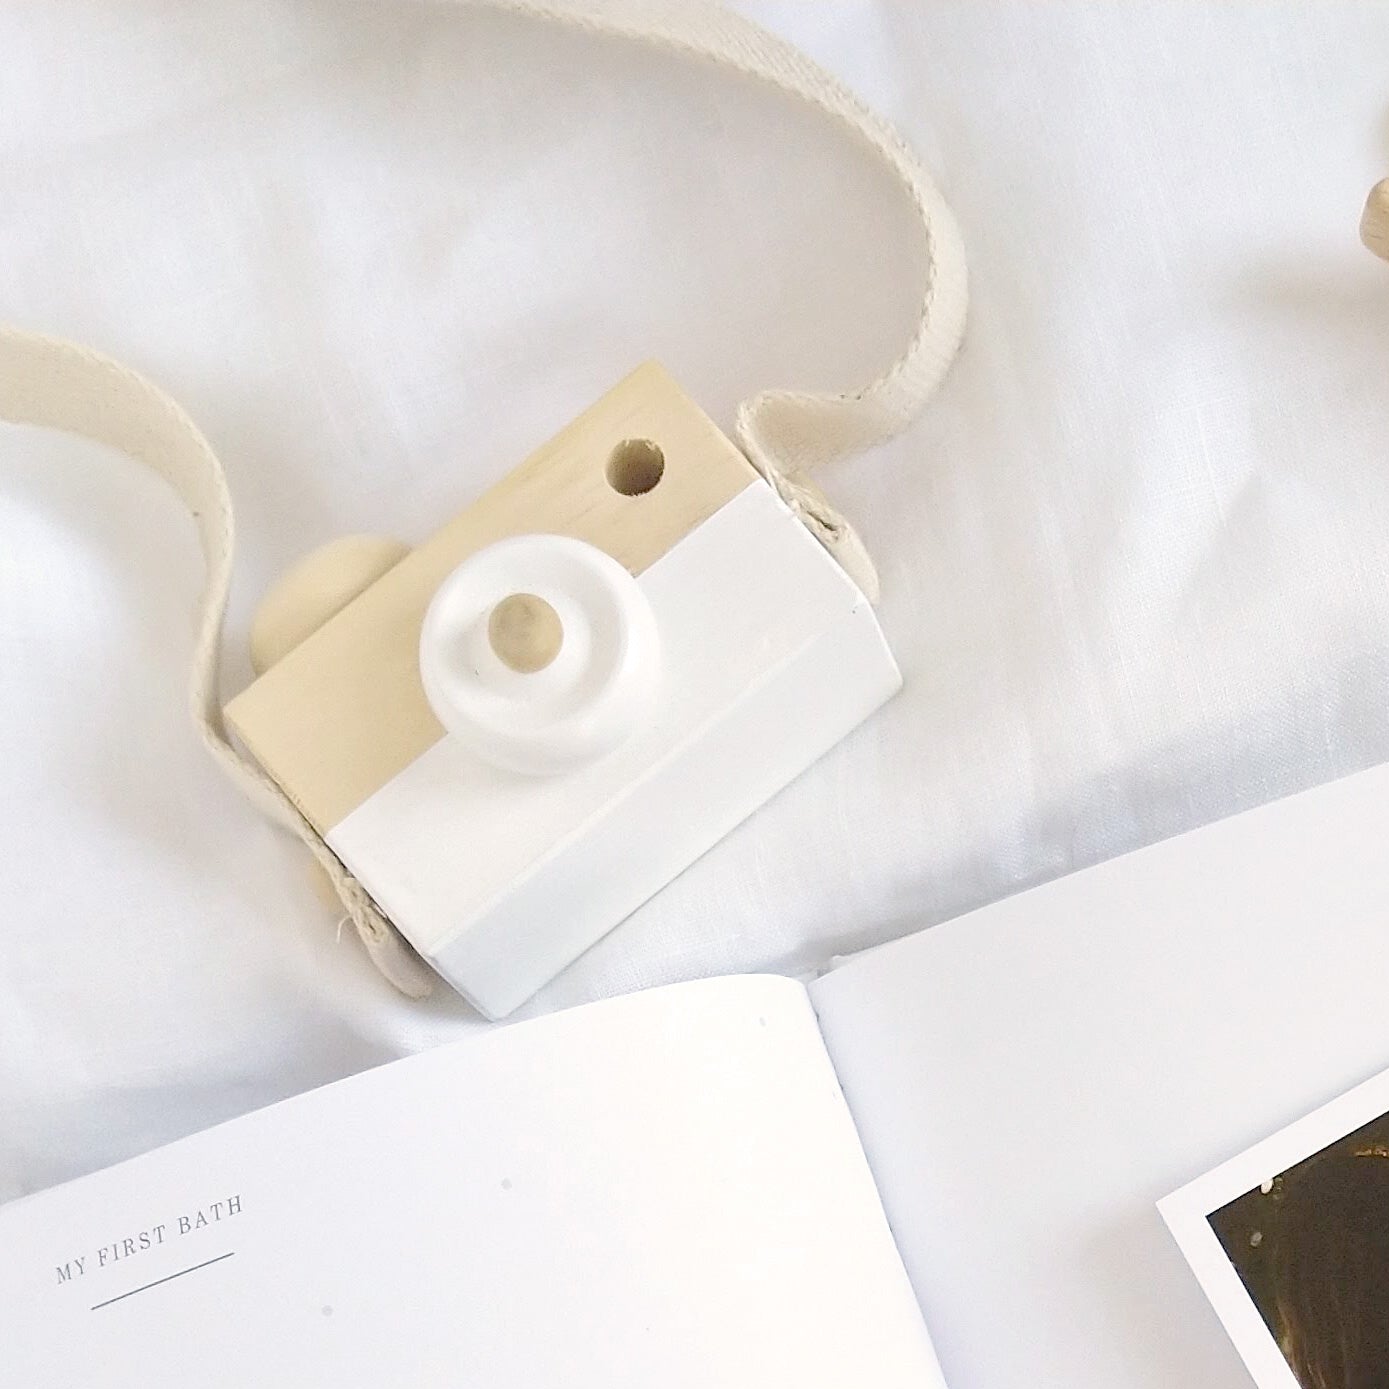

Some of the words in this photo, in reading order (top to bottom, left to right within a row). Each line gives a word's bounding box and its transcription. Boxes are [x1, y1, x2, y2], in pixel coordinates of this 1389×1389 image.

[55, 1256, 86, 1284] MY
[97, 1224, 166, 1267] FIRST
[177, 1195, 243, 1236] BATH
